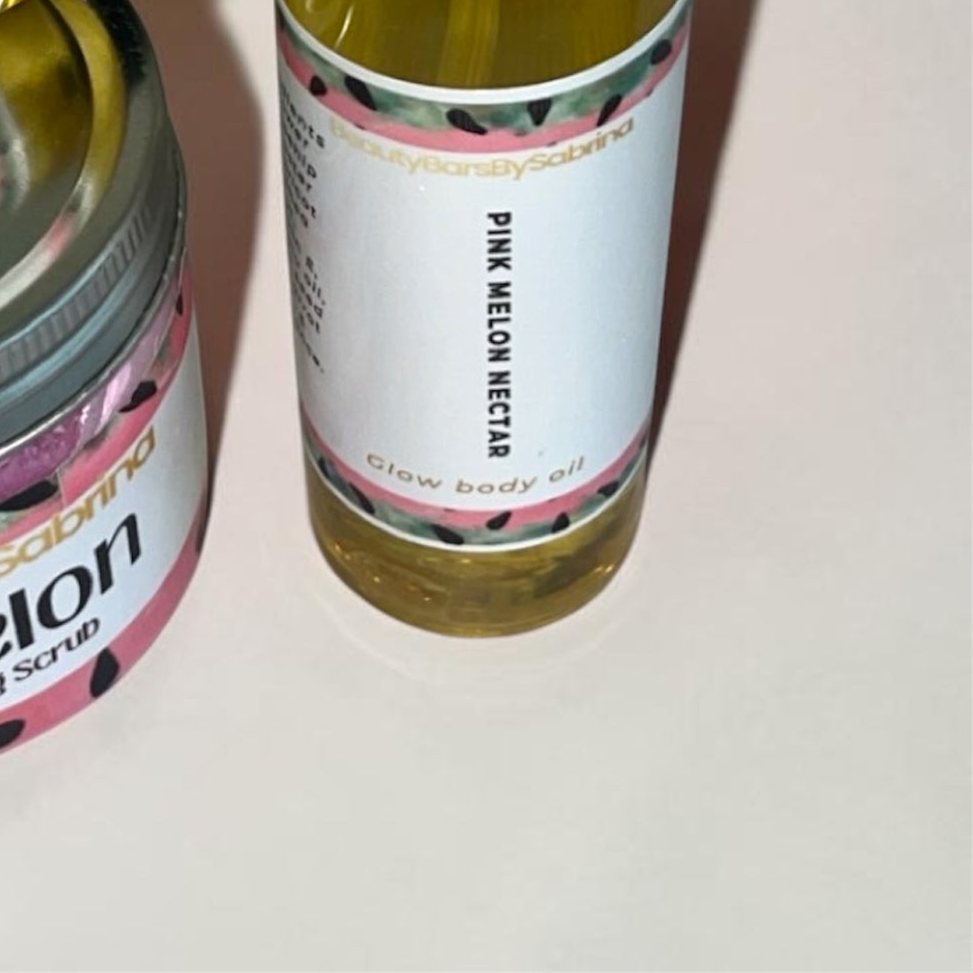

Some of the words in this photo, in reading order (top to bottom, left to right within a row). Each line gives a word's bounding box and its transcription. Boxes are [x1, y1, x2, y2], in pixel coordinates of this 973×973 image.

[329, 116, 634, 180] BeautyBarsBySabrina
[487, 211, 512, 272] PINK
[487, 281, 512, 363] MELON
[488, 370, 512, 459] NECTAR
[366, 453, 442, 490] Glow
[456, 476, 536, 495] body
[549, 456, 585, 484] oil
